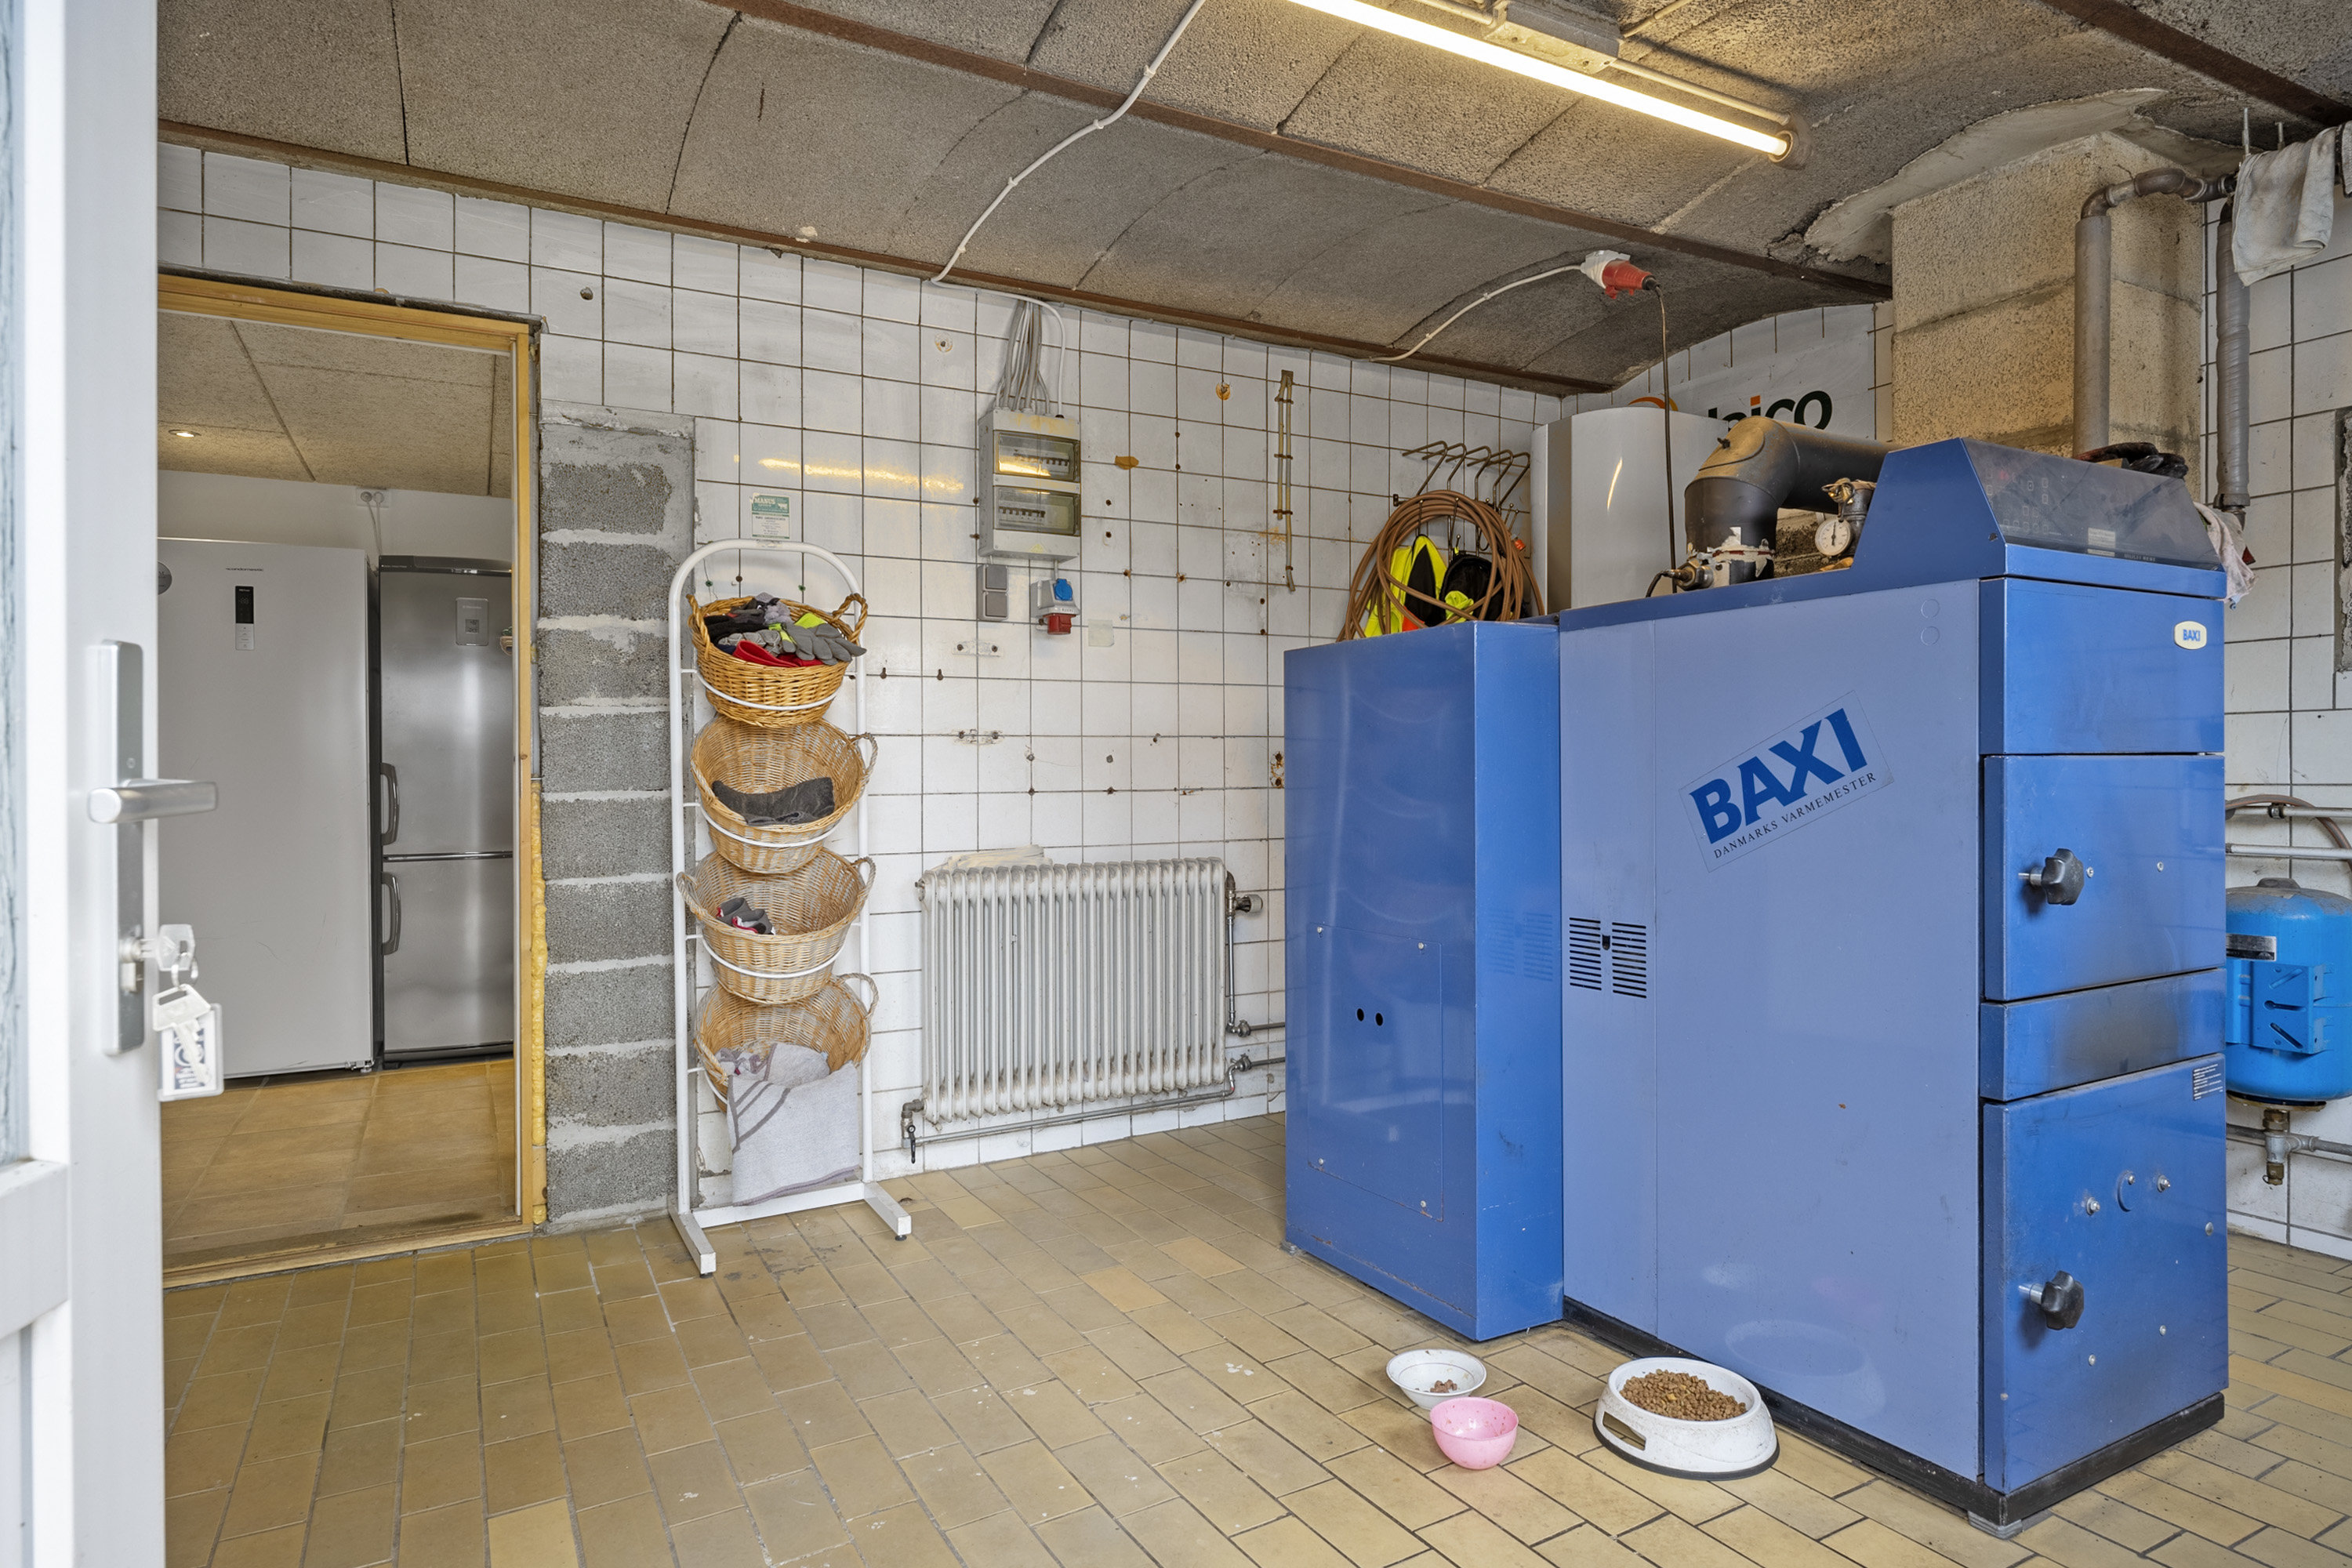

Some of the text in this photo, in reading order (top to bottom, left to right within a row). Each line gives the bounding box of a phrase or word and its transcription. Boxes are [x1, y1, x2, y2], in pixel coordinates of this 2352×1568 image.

[2183, 629, 2201, 642] BAXI
[1689, 707, 1867, 844] BAXI
[1714, 771, 1876, 858] DANMARKS VARMEMESTER
